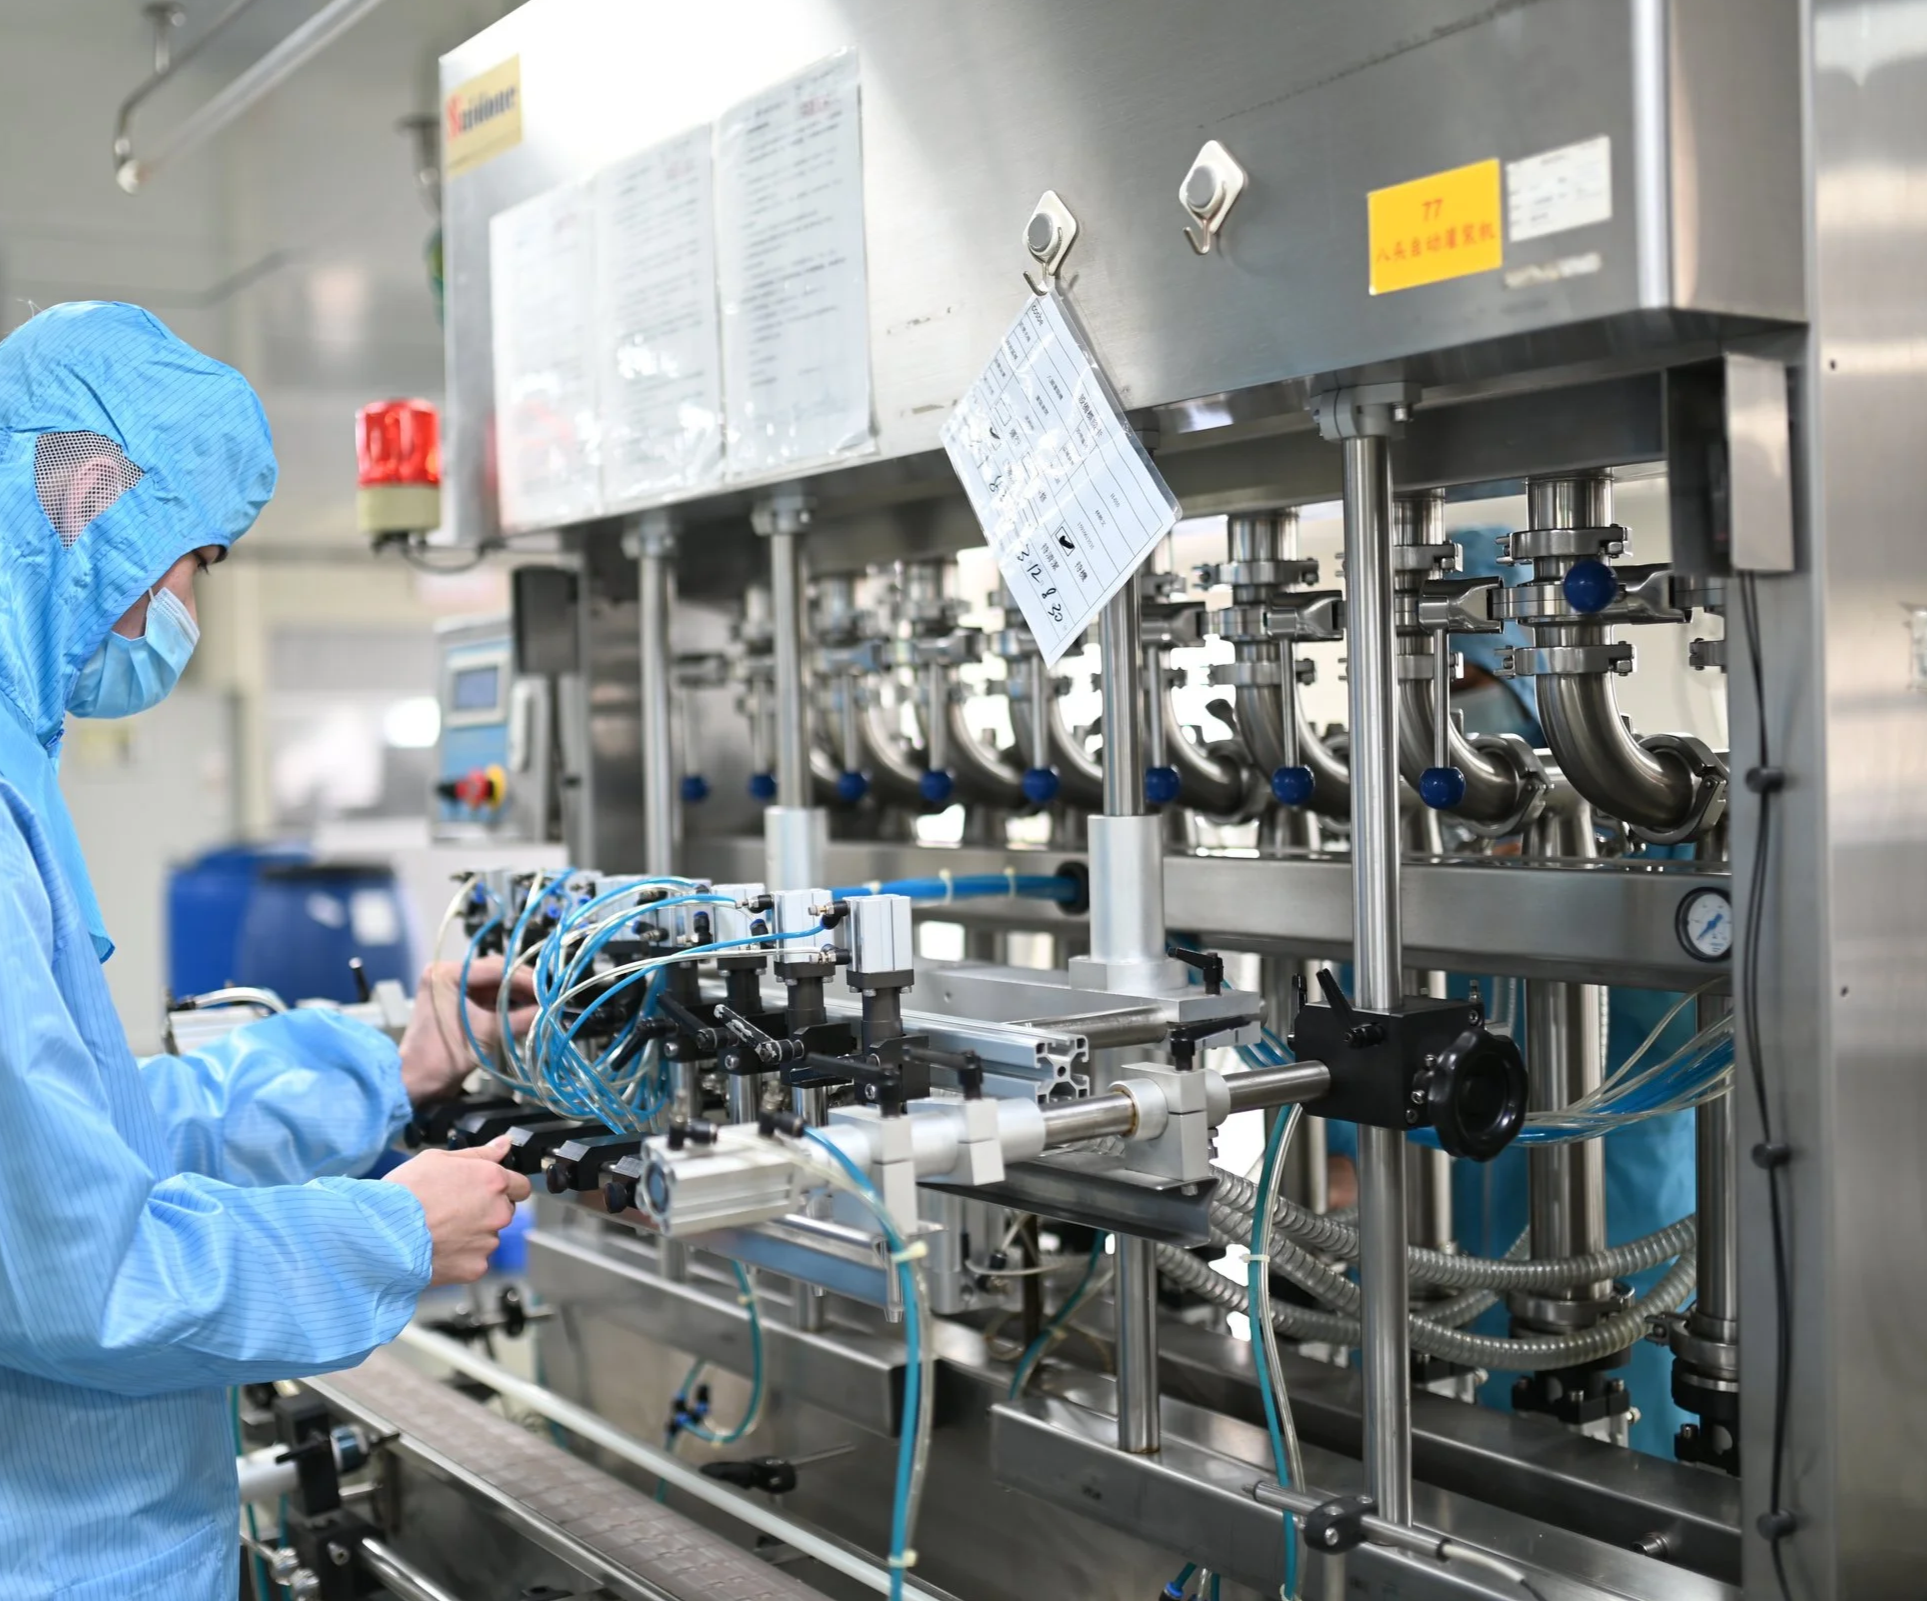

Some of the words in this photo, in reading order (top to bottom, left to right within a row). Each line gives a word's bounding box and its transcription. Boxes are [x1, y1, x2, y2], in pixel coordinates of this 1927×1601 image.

[1422, 198, 1443, 221] 77
[1027, 564, 1042, 583] 12
[1047, 603, 1064, 622] 30
